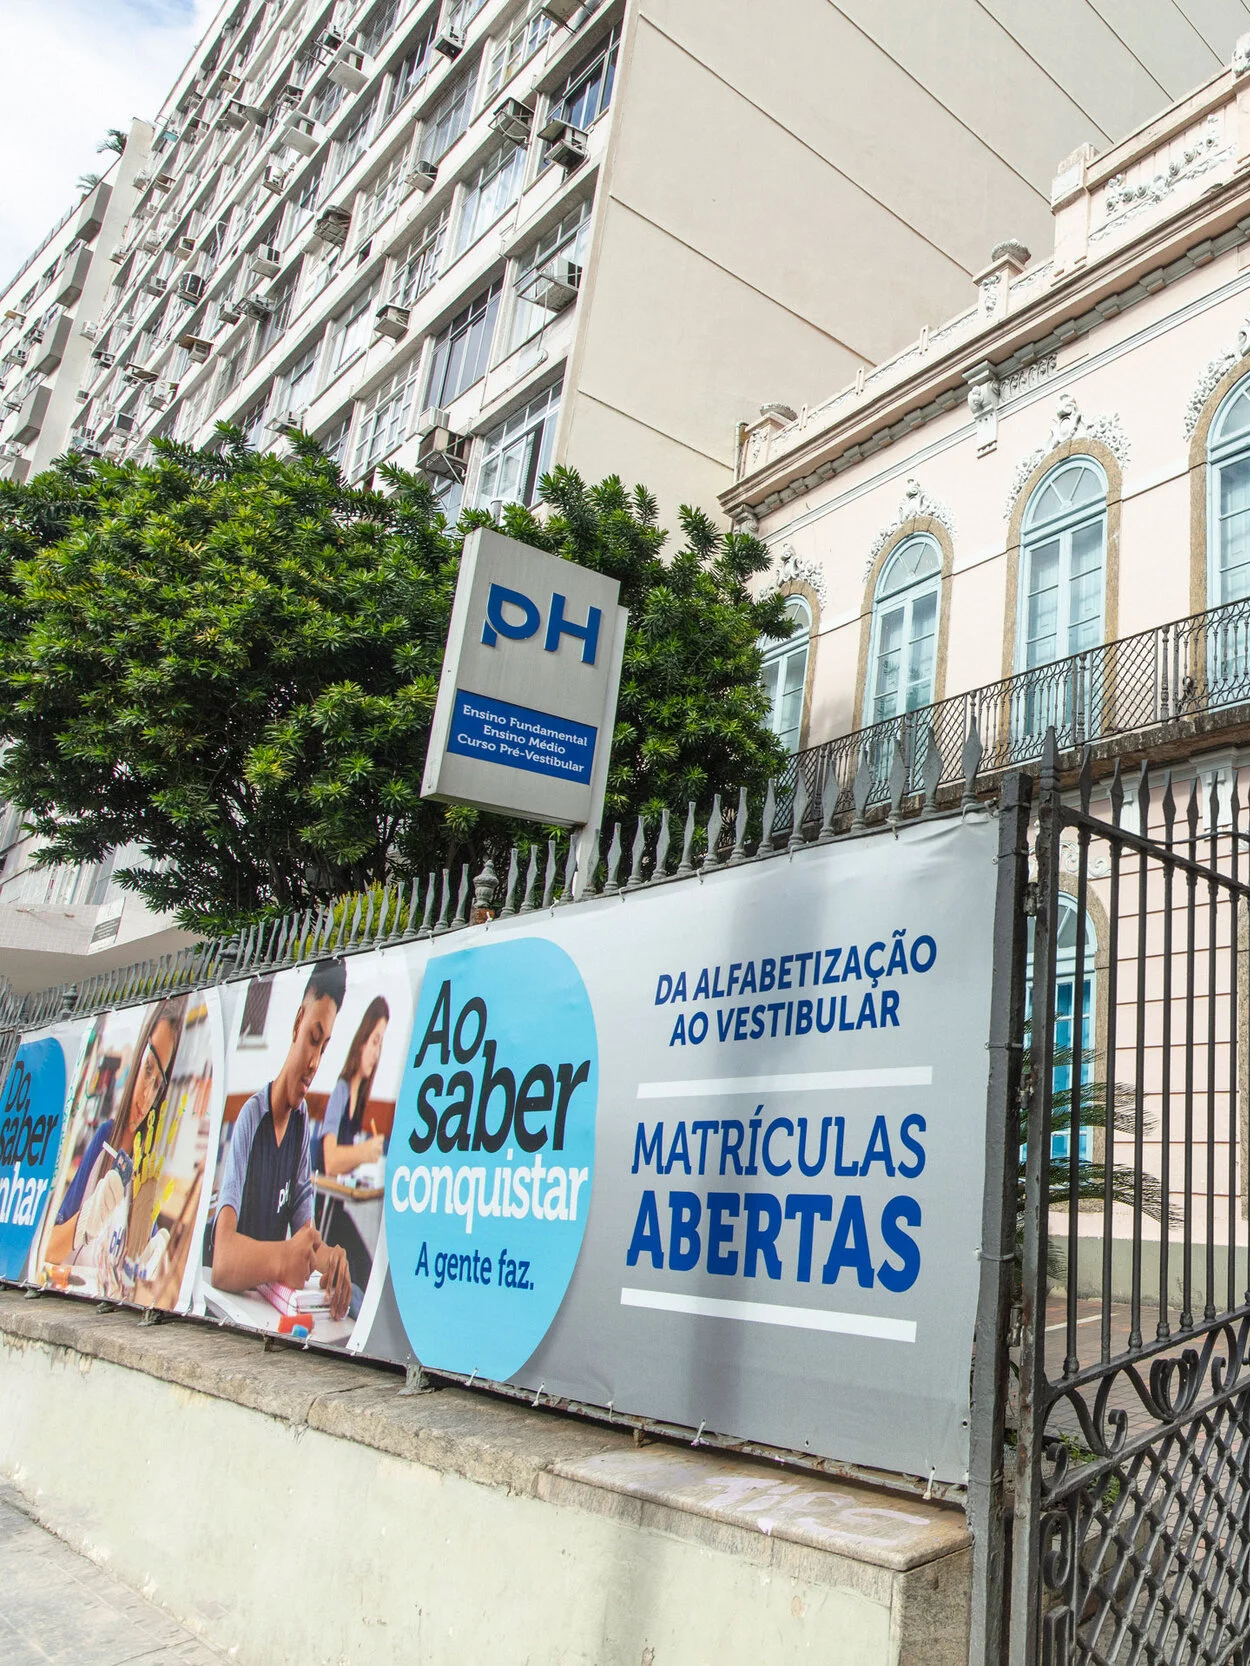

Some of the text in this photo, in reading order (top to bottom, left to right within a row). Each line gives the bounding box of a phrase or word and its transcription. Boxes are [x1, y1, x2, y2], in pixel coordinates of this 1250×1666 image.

[457, 733, 584, 772] Curso Pré-Vestibular
[463, 704, 588, 746] Ensino Fundamental
[483, 725, 566, 754] Ensino Médio
[654, 929, 937, 1006] DA ALFABETIZAÇÃO
[413, 979, 488, 1069] Ao
[669, 990, 900, 1046] AO VESTIBULAR
[408, 1039, 591, 1153] saber
[631, 1105, 926, 1179] MATRÍCULAS
[391, 1148, 588, 1234] conquistar
[415, 1241, 534, 1290] A gente faz.
[626, 1190, 922, 1293] ABERTAS
